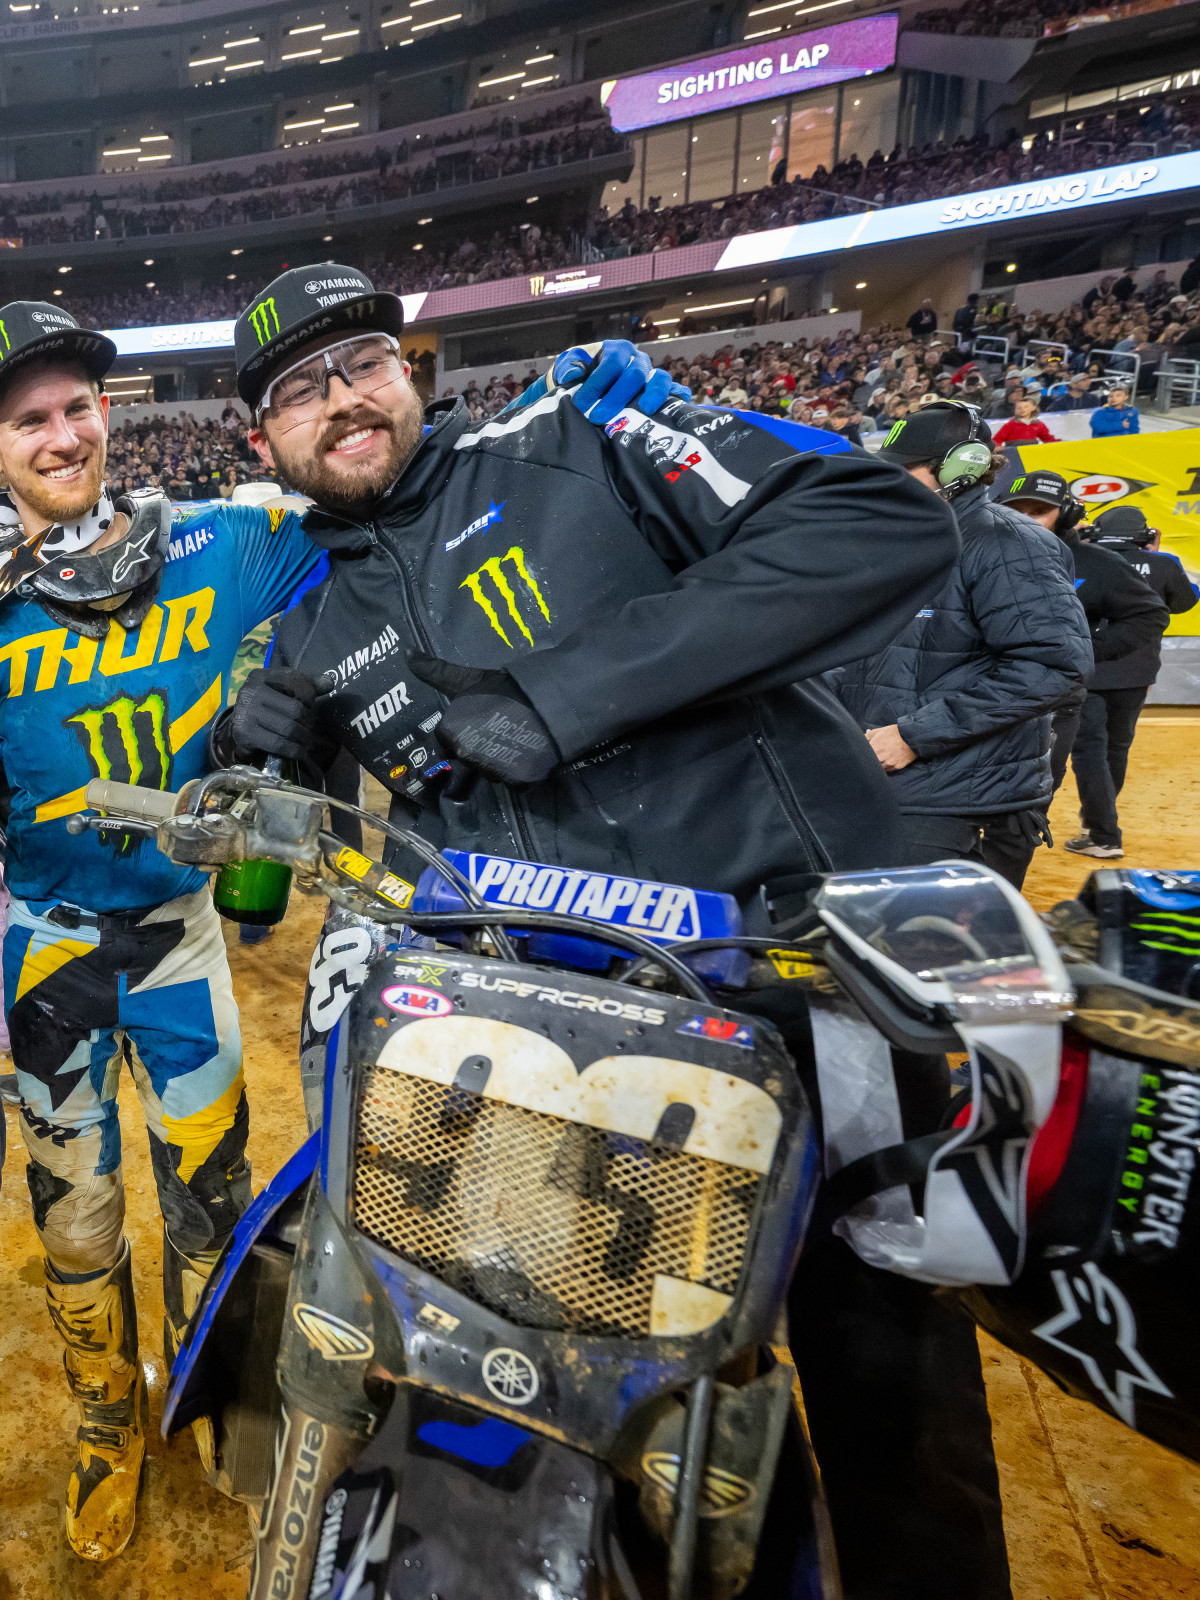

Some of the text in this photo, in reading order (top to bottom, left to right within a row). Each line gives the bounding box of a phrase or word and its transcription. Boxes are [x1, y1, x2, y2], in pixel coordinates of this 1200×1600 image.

[34, 20, 80, 36] HARRIS
[657, 43, 830, 104] SIGHTING LAP
[939, 166, 1159, 224] SIGHTING LAP
[319, 277, 366, 290] YAMAHA
[151, 325, 235, 347] SIGHTING
[263, 316, 333, 362] YAMAHA
[693, 413, 734, 437] KYB
[329, 646, 400, 697] RACING
[338, 624, 400, 680] YAMAHA
[350, 681, 413, 739] THOR
[99, 820, 123, 830] ARC
[476, 858, 691, 934] PROTAPER
[392, 991, 439, 1012] AMA
[393, 964, 667, 1026] SMX SUPERCROSS
[675, 1013, 756, 1050] AMA
